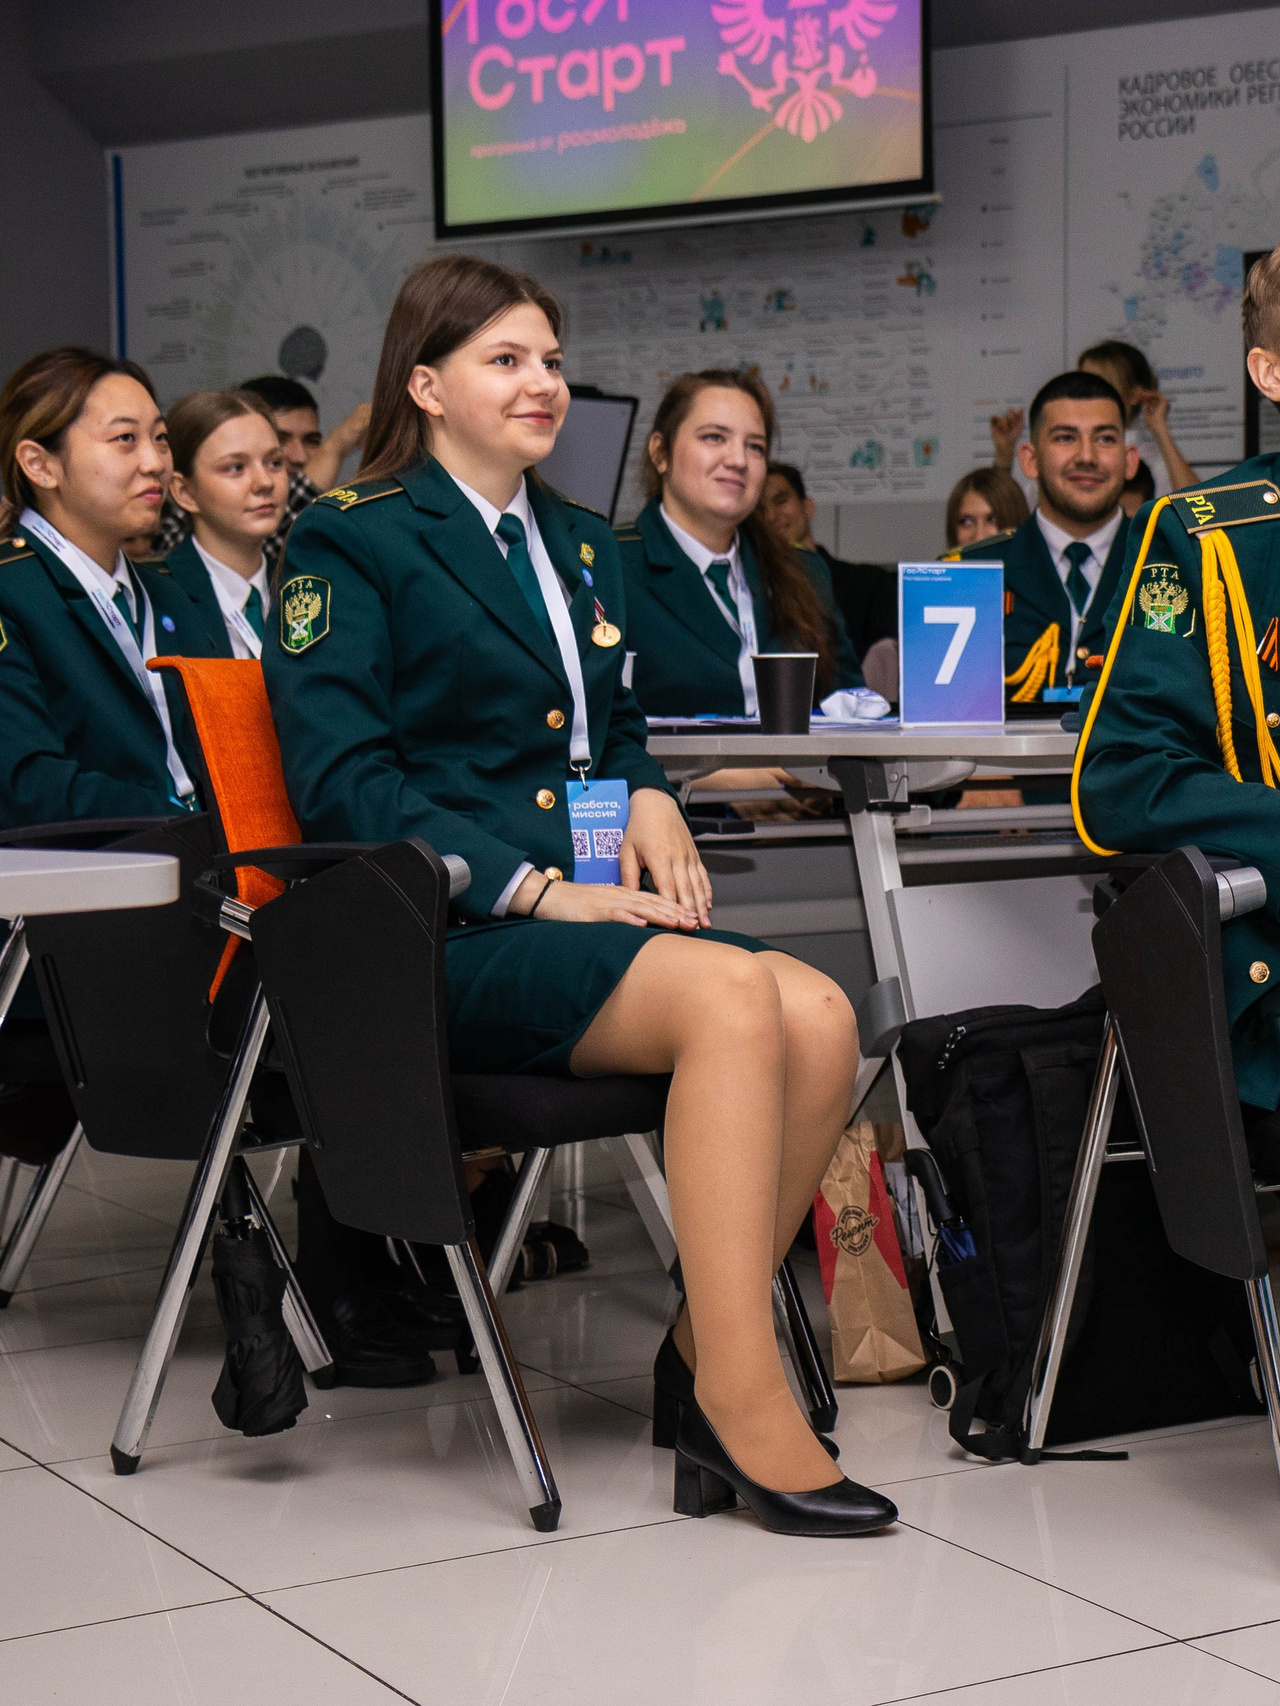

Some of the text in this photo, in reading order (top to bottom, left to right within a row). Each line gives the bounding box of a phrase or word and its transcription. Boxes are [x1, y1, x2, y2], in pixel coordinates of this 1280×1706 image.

[468, 35, 687, 112] Старт
[1118, 65, 1217, 95] КАДРОВОЕ
[1118, 86, 1241, 120] ЭКОНОМИКИ
[1118, 115, 1197, 142] РОССИИ
[1185, 494, 1217, 526] РТА
[291, 579, 313, 593] РТА
[1150, 566, 1181, 581] РТА
[923, 606, 976, 685] 7
[571, 810, 617, 819] миссия
[573, 800, 621, 811] работа,
